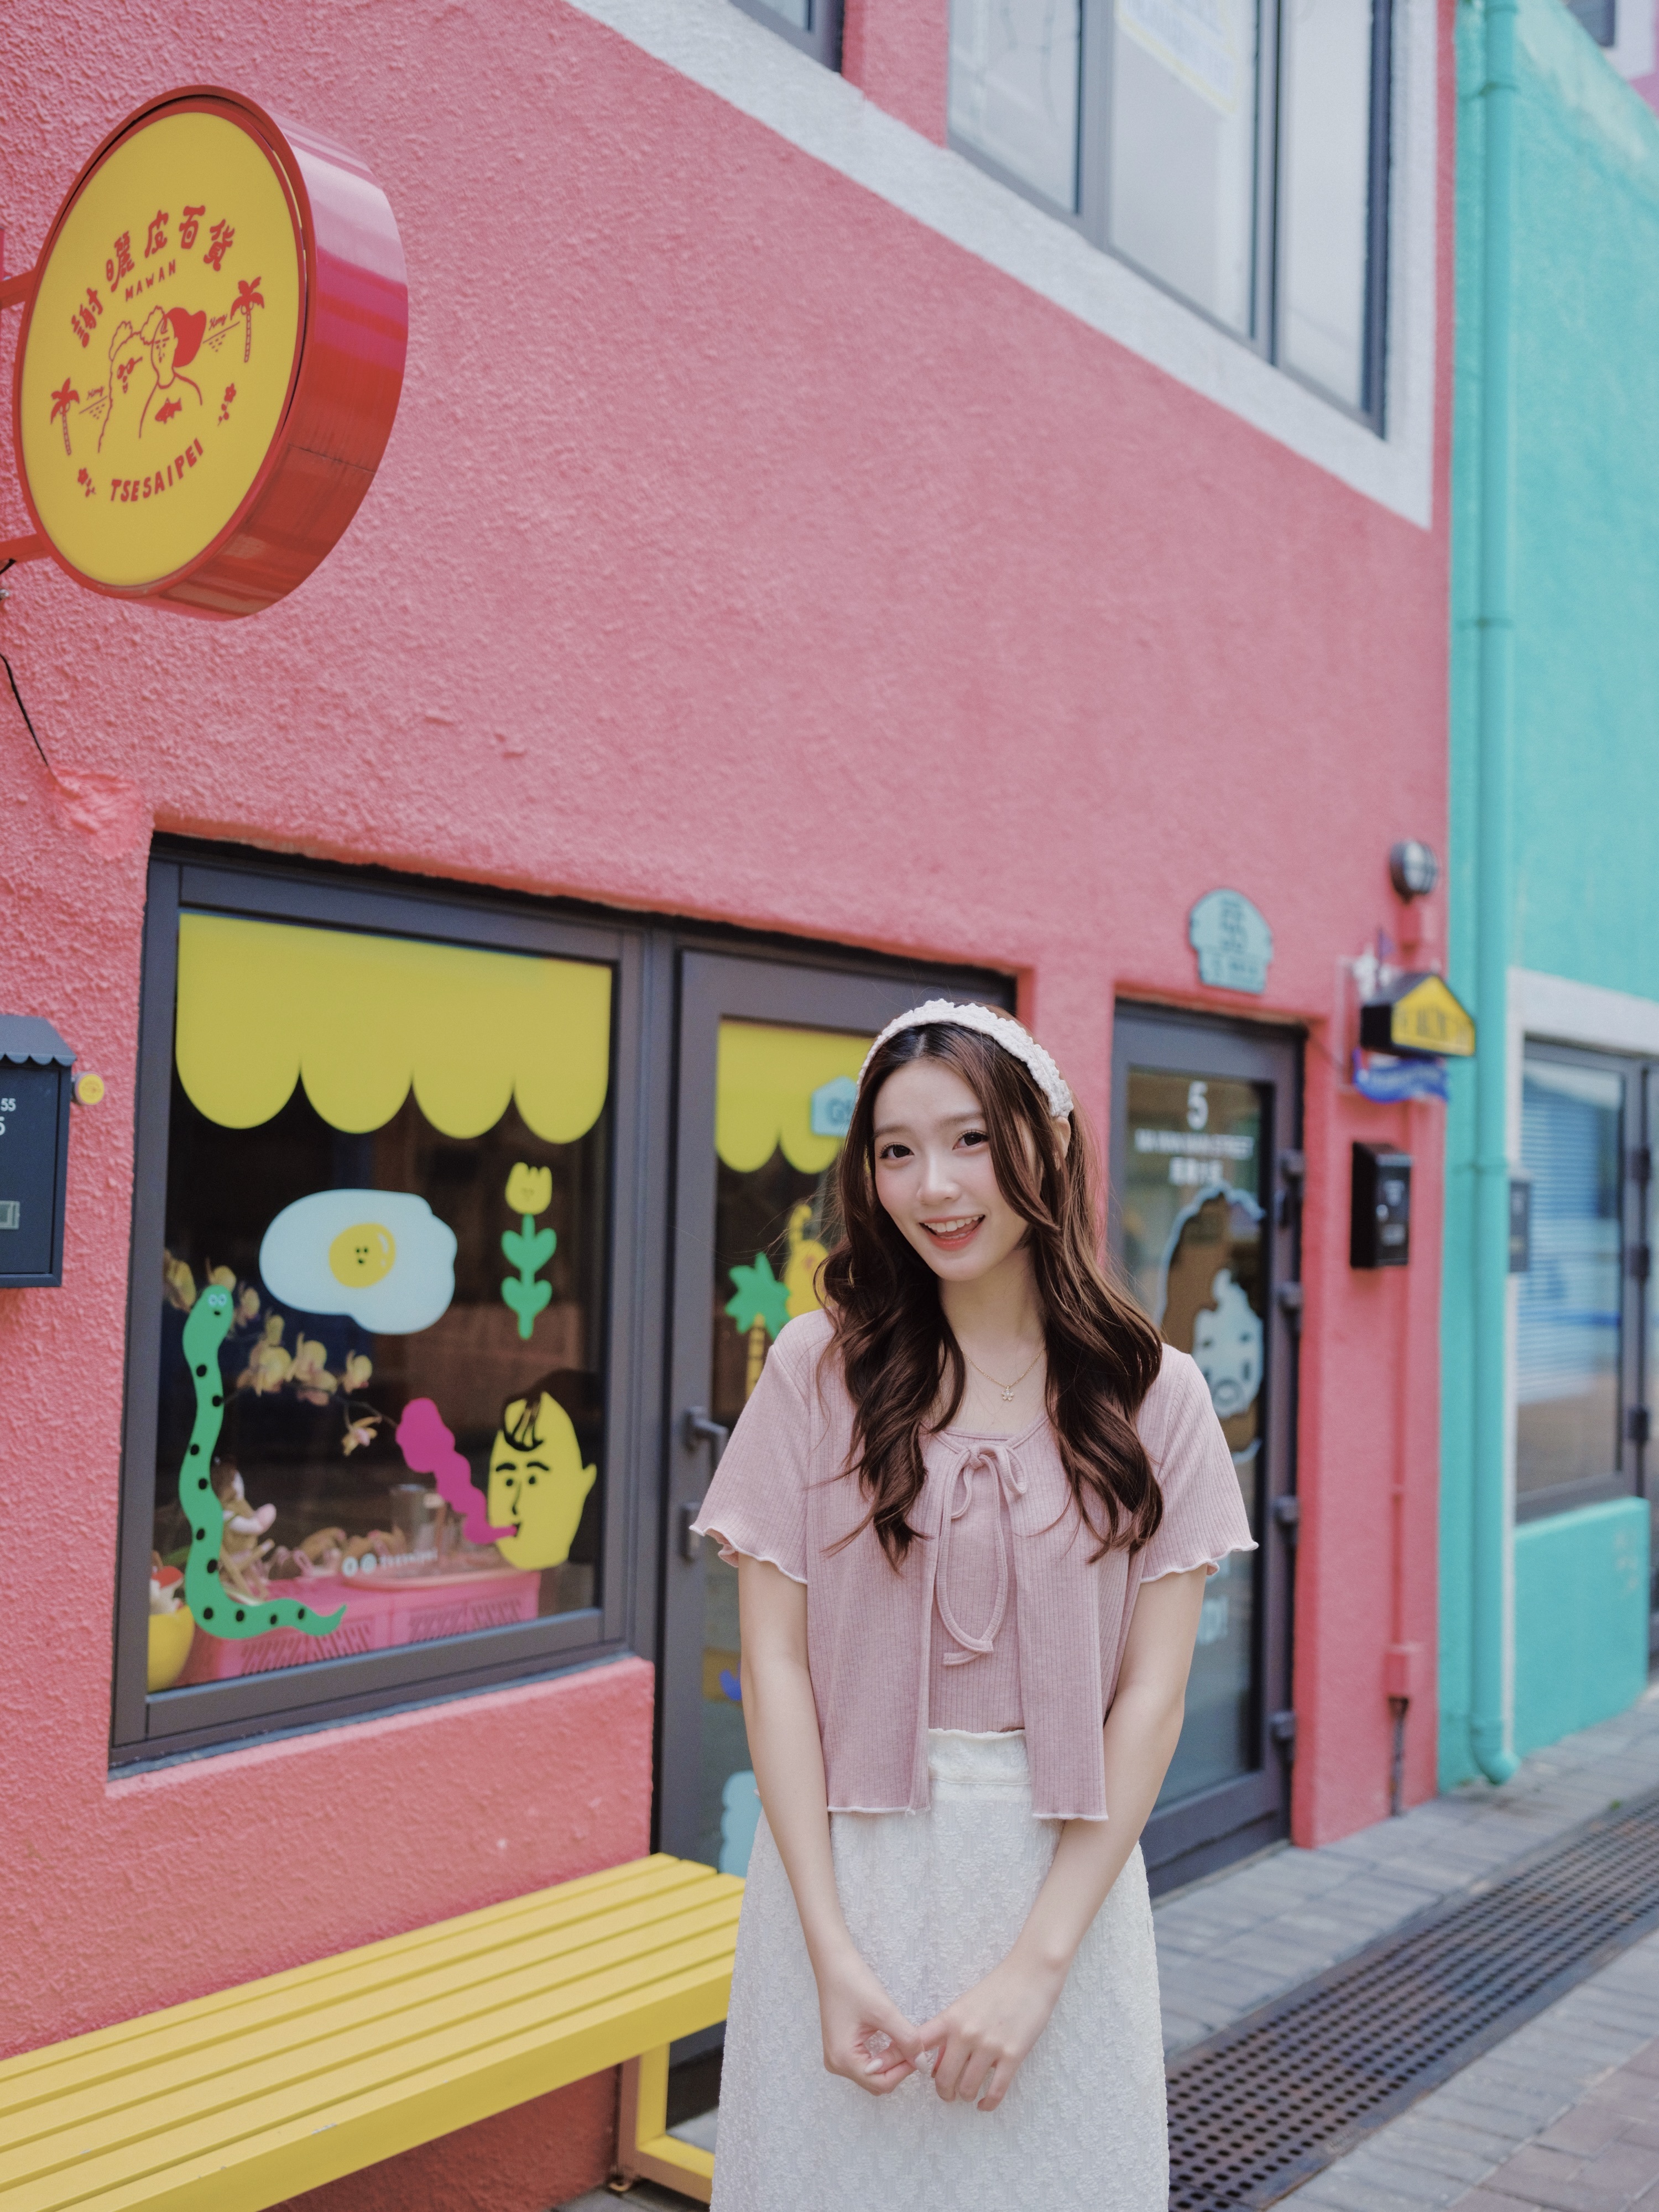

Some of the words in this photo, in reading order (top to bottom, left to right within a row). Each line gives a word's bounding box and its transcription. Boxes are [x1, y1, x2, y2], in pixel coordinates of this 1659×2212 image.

[111, 437, 204, 502] TSESAIPEI
[0, 1097, 16, 1112] 55
[1187, 1080, 1209, 1131] 5
